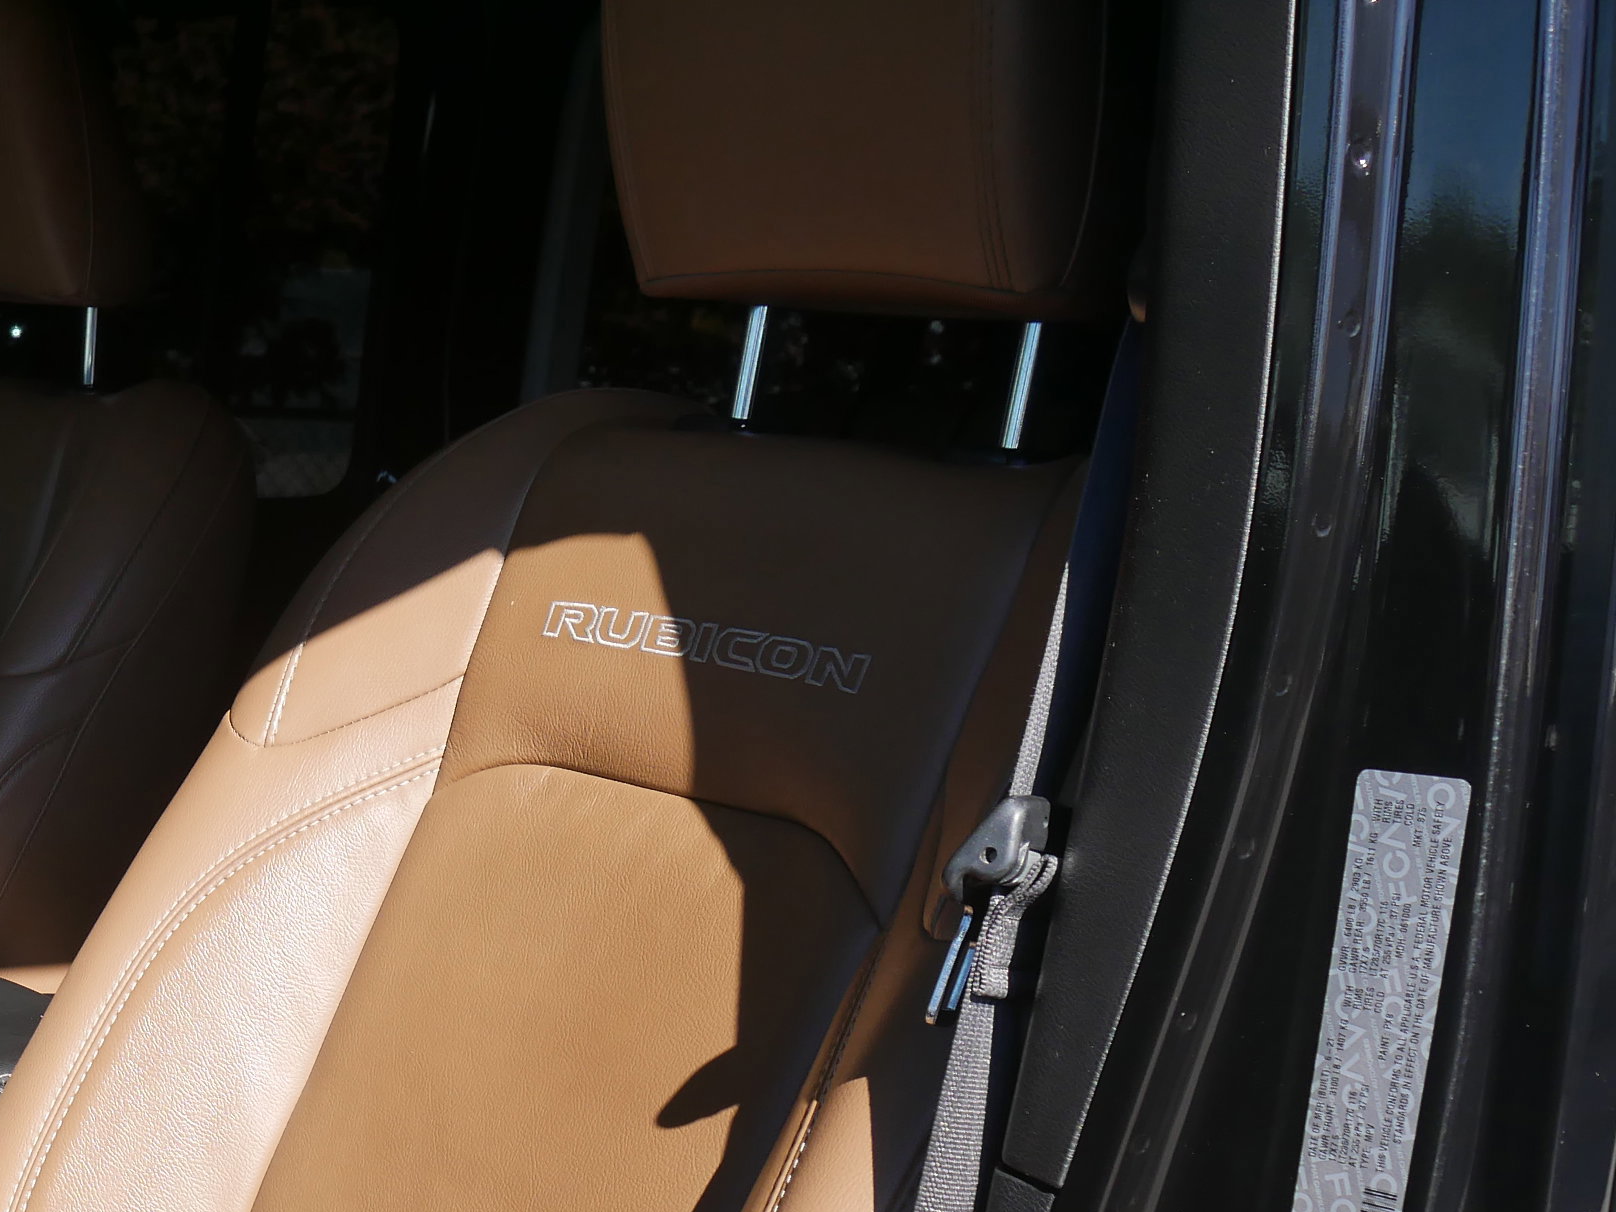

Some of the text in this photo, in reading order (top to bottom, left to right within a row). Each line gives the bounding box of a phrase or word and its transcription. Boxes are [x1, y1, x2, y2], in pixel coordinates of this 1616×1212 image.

[542, 600, 872, 694] RUBICON
[1373, 798, 1384, 822] WITH
[1382, 800, 1394, 823] RIMS
[1393, 799, 1405, 824] TIRES
[1432, 800, 1445, 835] SAFETY
[1391, 892, 1402, 906] PSI
[1404, 802, 1416, 826] COLD
[1425, 837, 1439, 874] VEHICLE
[1420, 876, 1433, 907] MOTOR
[1434, 868, 1447, 901] SHOWN
[1413, 909, 1427, 950] FEDERAL
[1422, 904, 1441, 969] MANUFACTURE
[1344, 984, 1355, 1007] WITH
[1353, 987, 1364, 1009] RIMS
[1363, 985, 1375, 1011] TIRES
[1400, 982, 1415, 1033] APPLICABLE
[1416, 986, 1428, 1010] DATE
[1413, 1011, 1424, 1026] THE
[1360, 1083, 1370, 1098] PSI
[1374, 990, 1385, 1014] COLD
[1397, 1036, 1406, 1052] ALL
[1405, 1046, 1418, 1078] EFFECT
[1387, 1067, 1401, 1115] CONFORMS
[1313, 1122, 1322, 1134] OF
[1365, 1122, 1376, 1142] MPV
[1394, 1092, 1410, 1144] STANDARDS
[1309, 1137, 1320, 1158] DATE
[1380, 1117, 1393, 1152] VEHICLE
[1377, 1153, 1387, 1172] THIS
